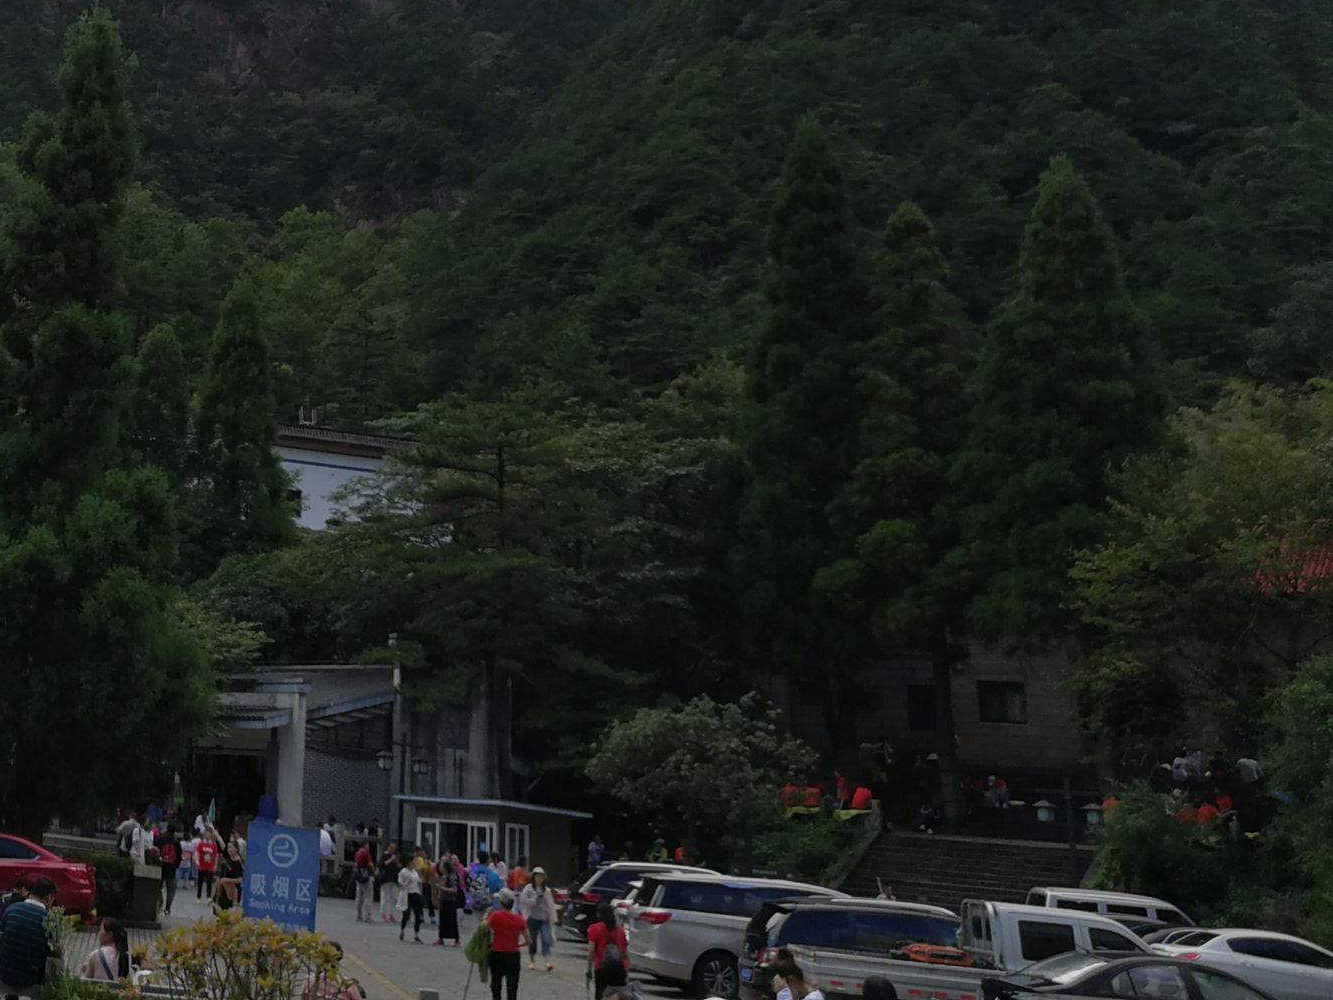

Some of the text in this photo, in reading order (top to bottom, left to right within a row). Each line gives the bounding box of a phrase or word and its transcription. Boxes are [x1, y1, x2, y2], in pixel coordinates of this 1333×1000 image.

[250, 873, 312, 902] 吸烟区
[249, 898, 310, 915] Smoking Area
